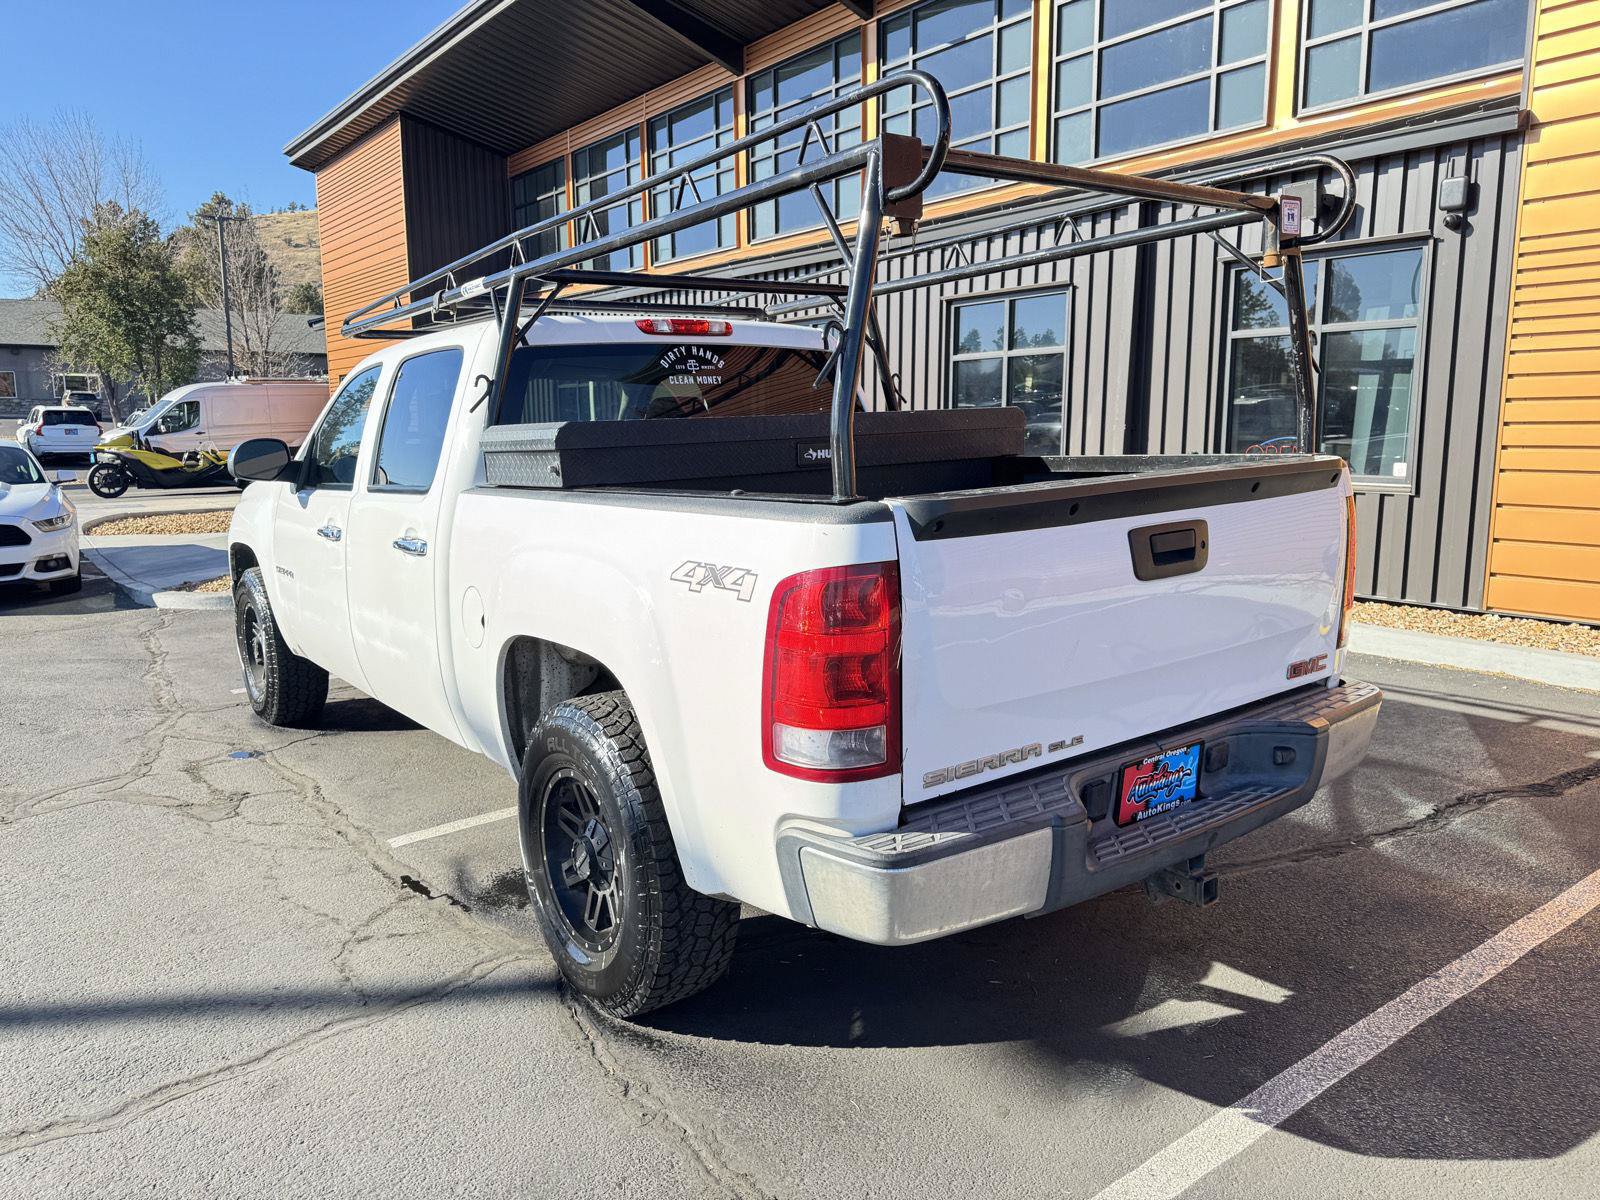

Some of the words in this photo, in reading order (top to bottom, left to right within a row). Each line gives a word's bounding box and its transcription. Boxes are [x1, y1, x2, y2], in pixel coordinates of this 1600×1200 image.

[660, 346, 686, 368] DIRTY
[692, 346, 725, 368] HANDS
[669, 375, 695, 384] CLEAN
[696, 375, 722, 384] MONEY
[1286, 653, 1328, 680] GMC
[923, 742, 1042, 789] SIERRA
[1048, 735, 1084, 753] SLE
[1143, 754, 1166, 765] Central
